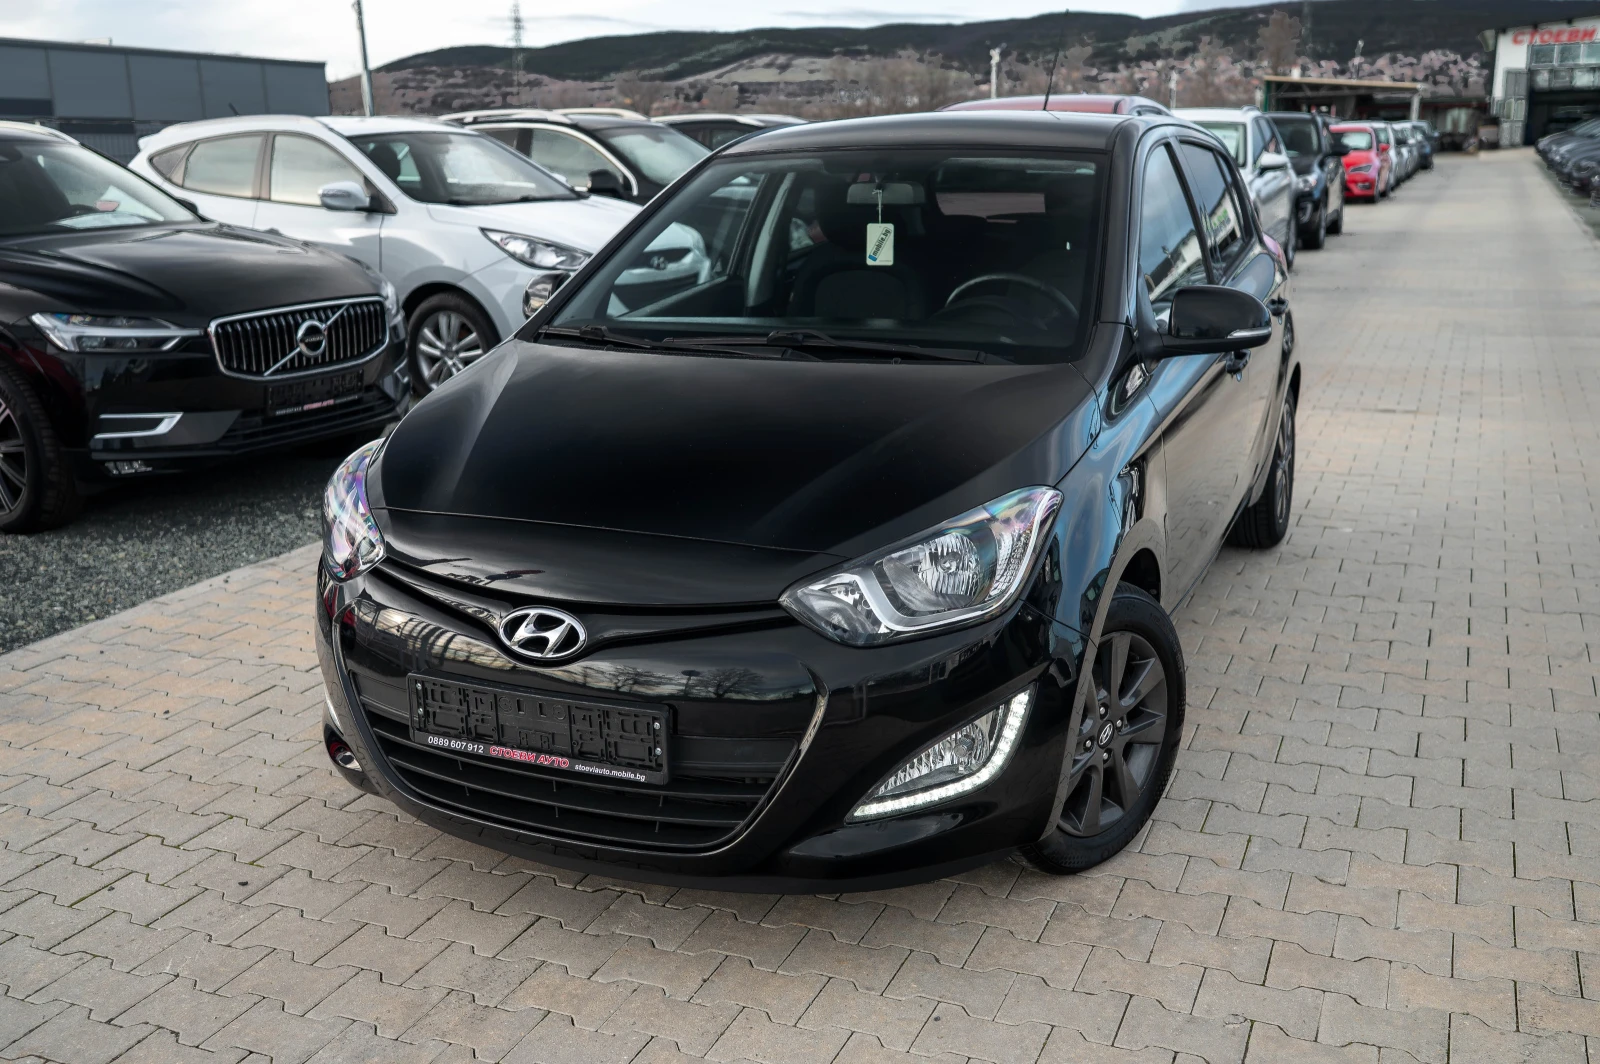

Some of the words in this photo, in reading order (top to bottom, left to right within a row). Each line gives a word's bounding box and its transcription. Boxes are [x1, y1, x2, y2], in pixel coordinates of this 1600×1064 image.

[872, 229, 891, 256] mobile.bg
[428, 736, 449, 747] 0889
[450, 740, 466, 750] 607
[467, 743, 484, 753] 912
[489, 746, 536, 762] СТОЕВИ
[537, 754, 569, 768] АУТО
[575, 764, 646, 782] stoeviauto.mobile.bg
